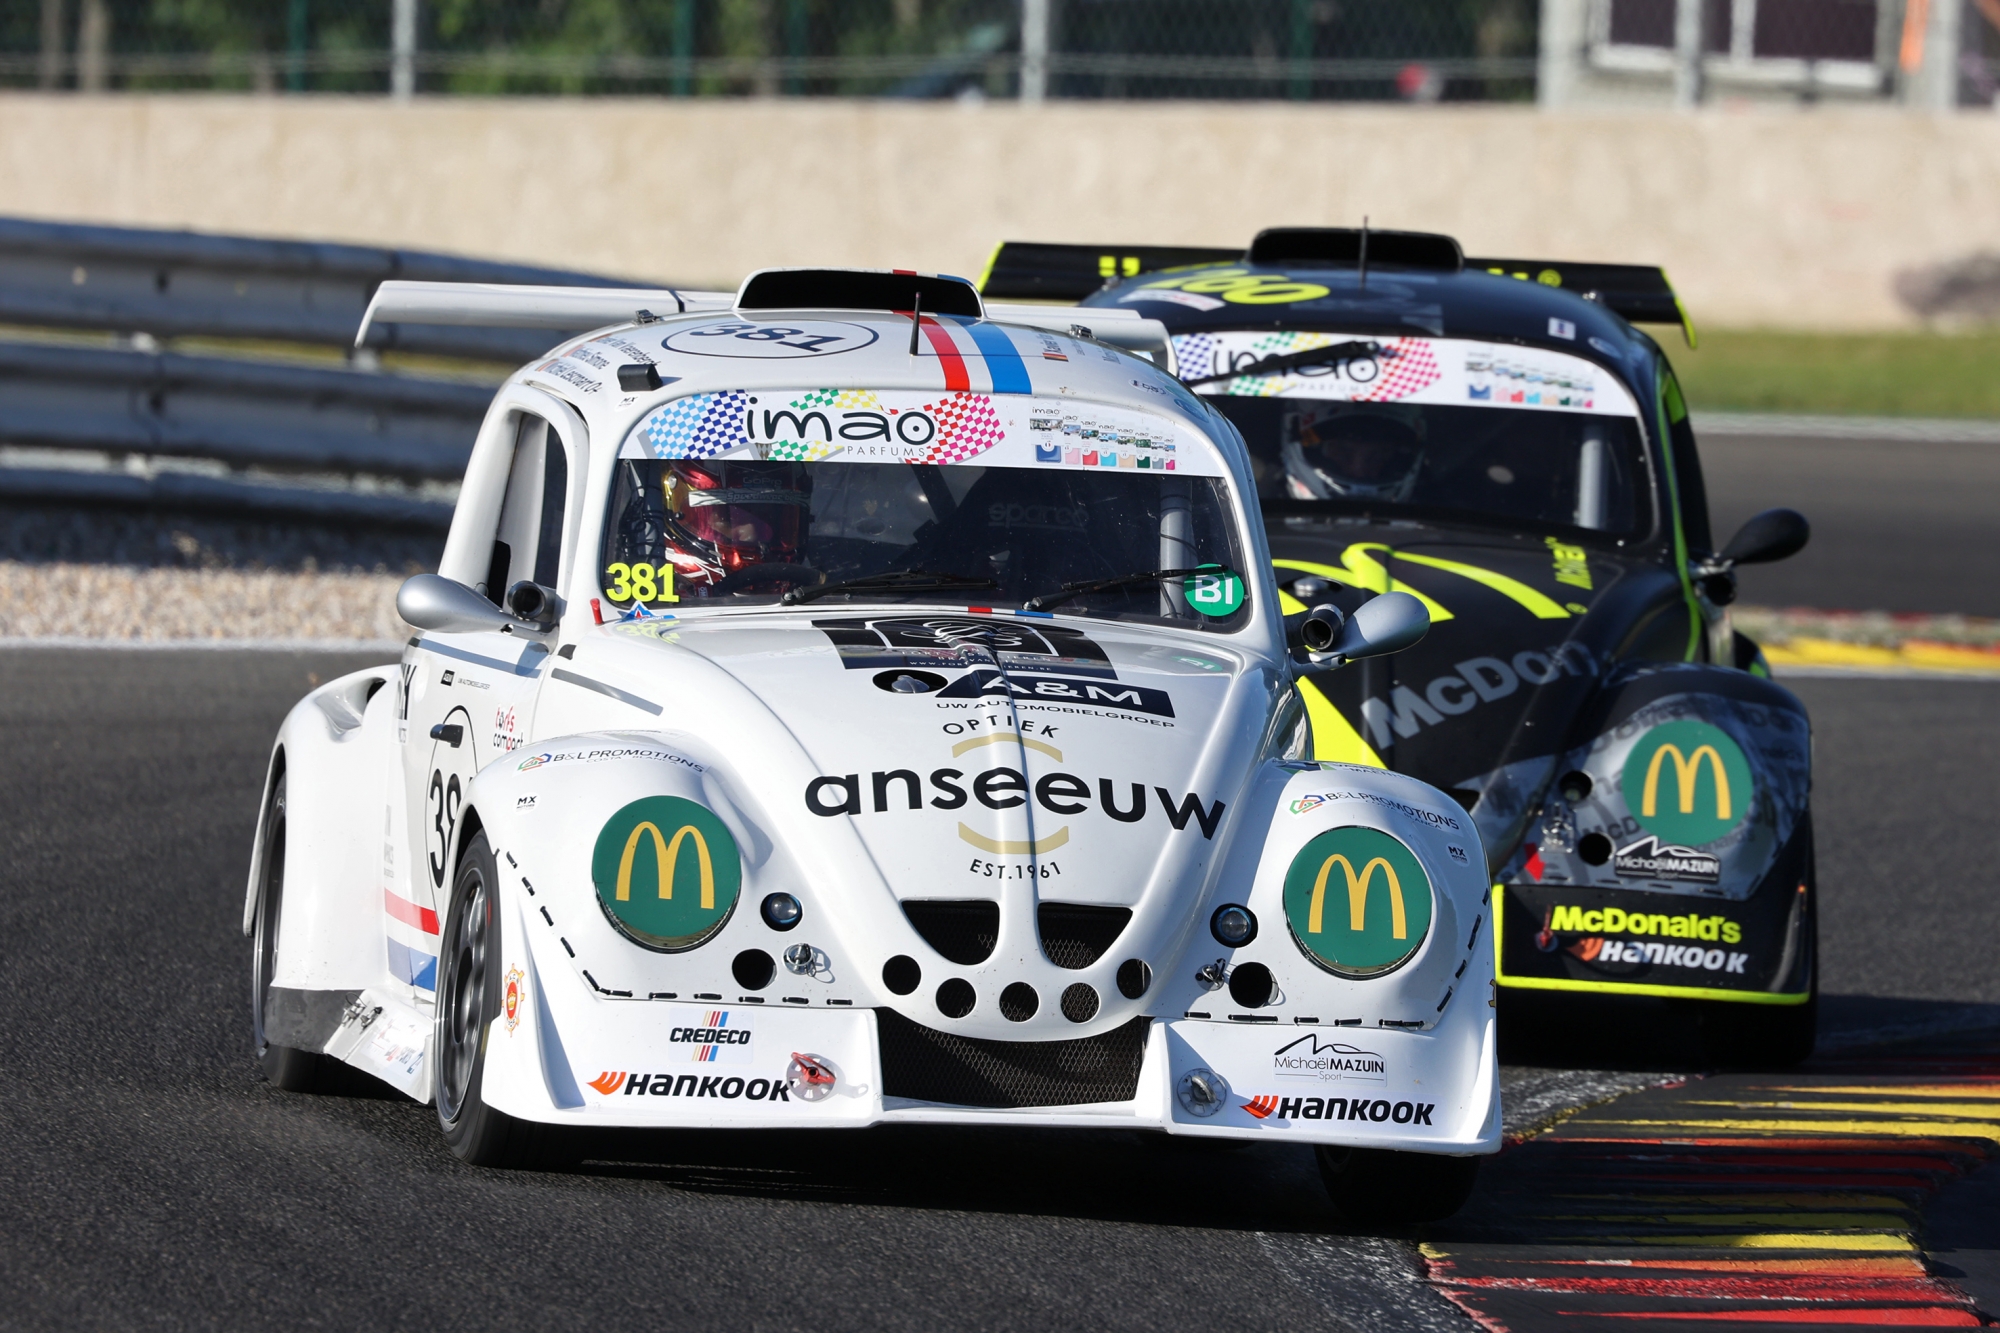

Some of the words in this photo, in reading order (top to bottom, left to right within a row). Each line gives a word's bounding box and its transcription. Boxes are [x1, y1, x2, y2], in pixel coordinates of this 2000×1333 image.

[689, 324, 847, 353] 381
[746, 396, 935, 446] imao
[847, 445, 926, 458] PARFUMS
[742, 476, 782, 486] GoPro
[606, 562, 680, 603] 381
[981, 676, 1143, 706] A&M
[942, 714, 1060, 739] OPTIEK
[974, 701, 1176, 728] AUTOMOBIELGROEP
[517, 796, 537, 805] MX
[804, 766, 1226, 841] anseeuw
[430, 768, 465, 889] 38
[1447, 846, 1467, 857] MX
[1550, 905, 1742, 944] McDonald's
[669, 1027, 751, 1045] CREDECO
[1318, 1070, 1343, 1082] Sport
